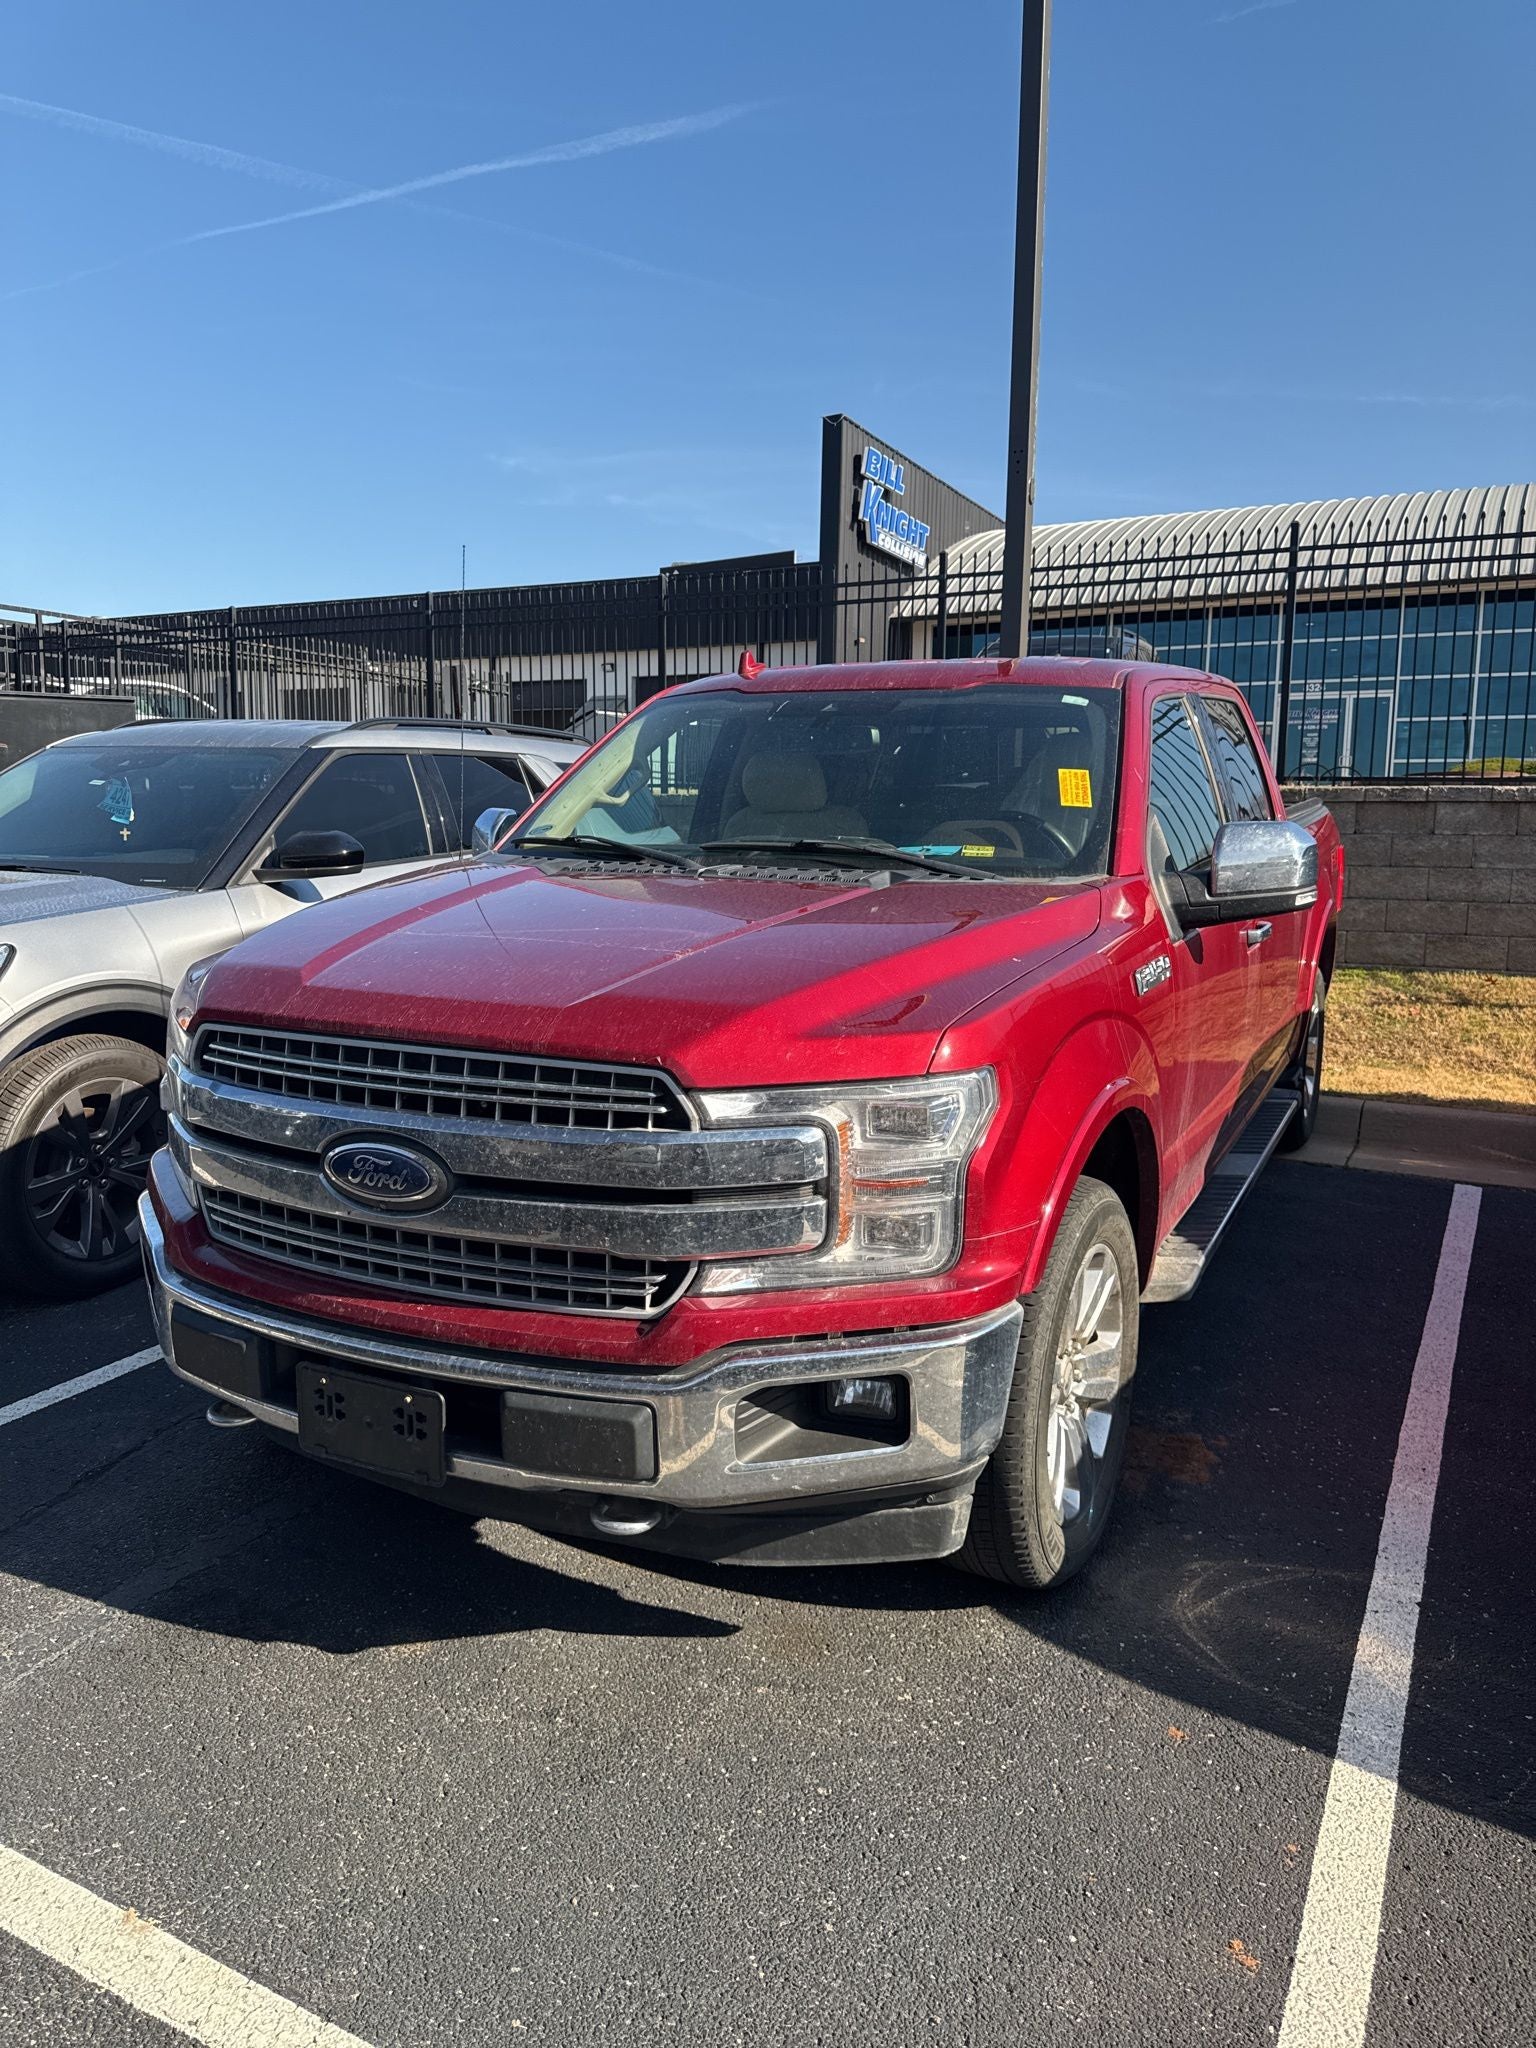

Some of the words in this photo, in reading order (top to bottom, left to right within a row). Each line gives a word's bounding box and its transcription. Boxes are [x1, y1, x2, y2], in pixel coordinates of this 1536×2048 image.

[862, 446, 905, 495] BILL
[860, 480, 930, 550] KNIGHT
[878, 533, 926, 567] COLLISION
[347, 1154, 408, 1191] Ford
